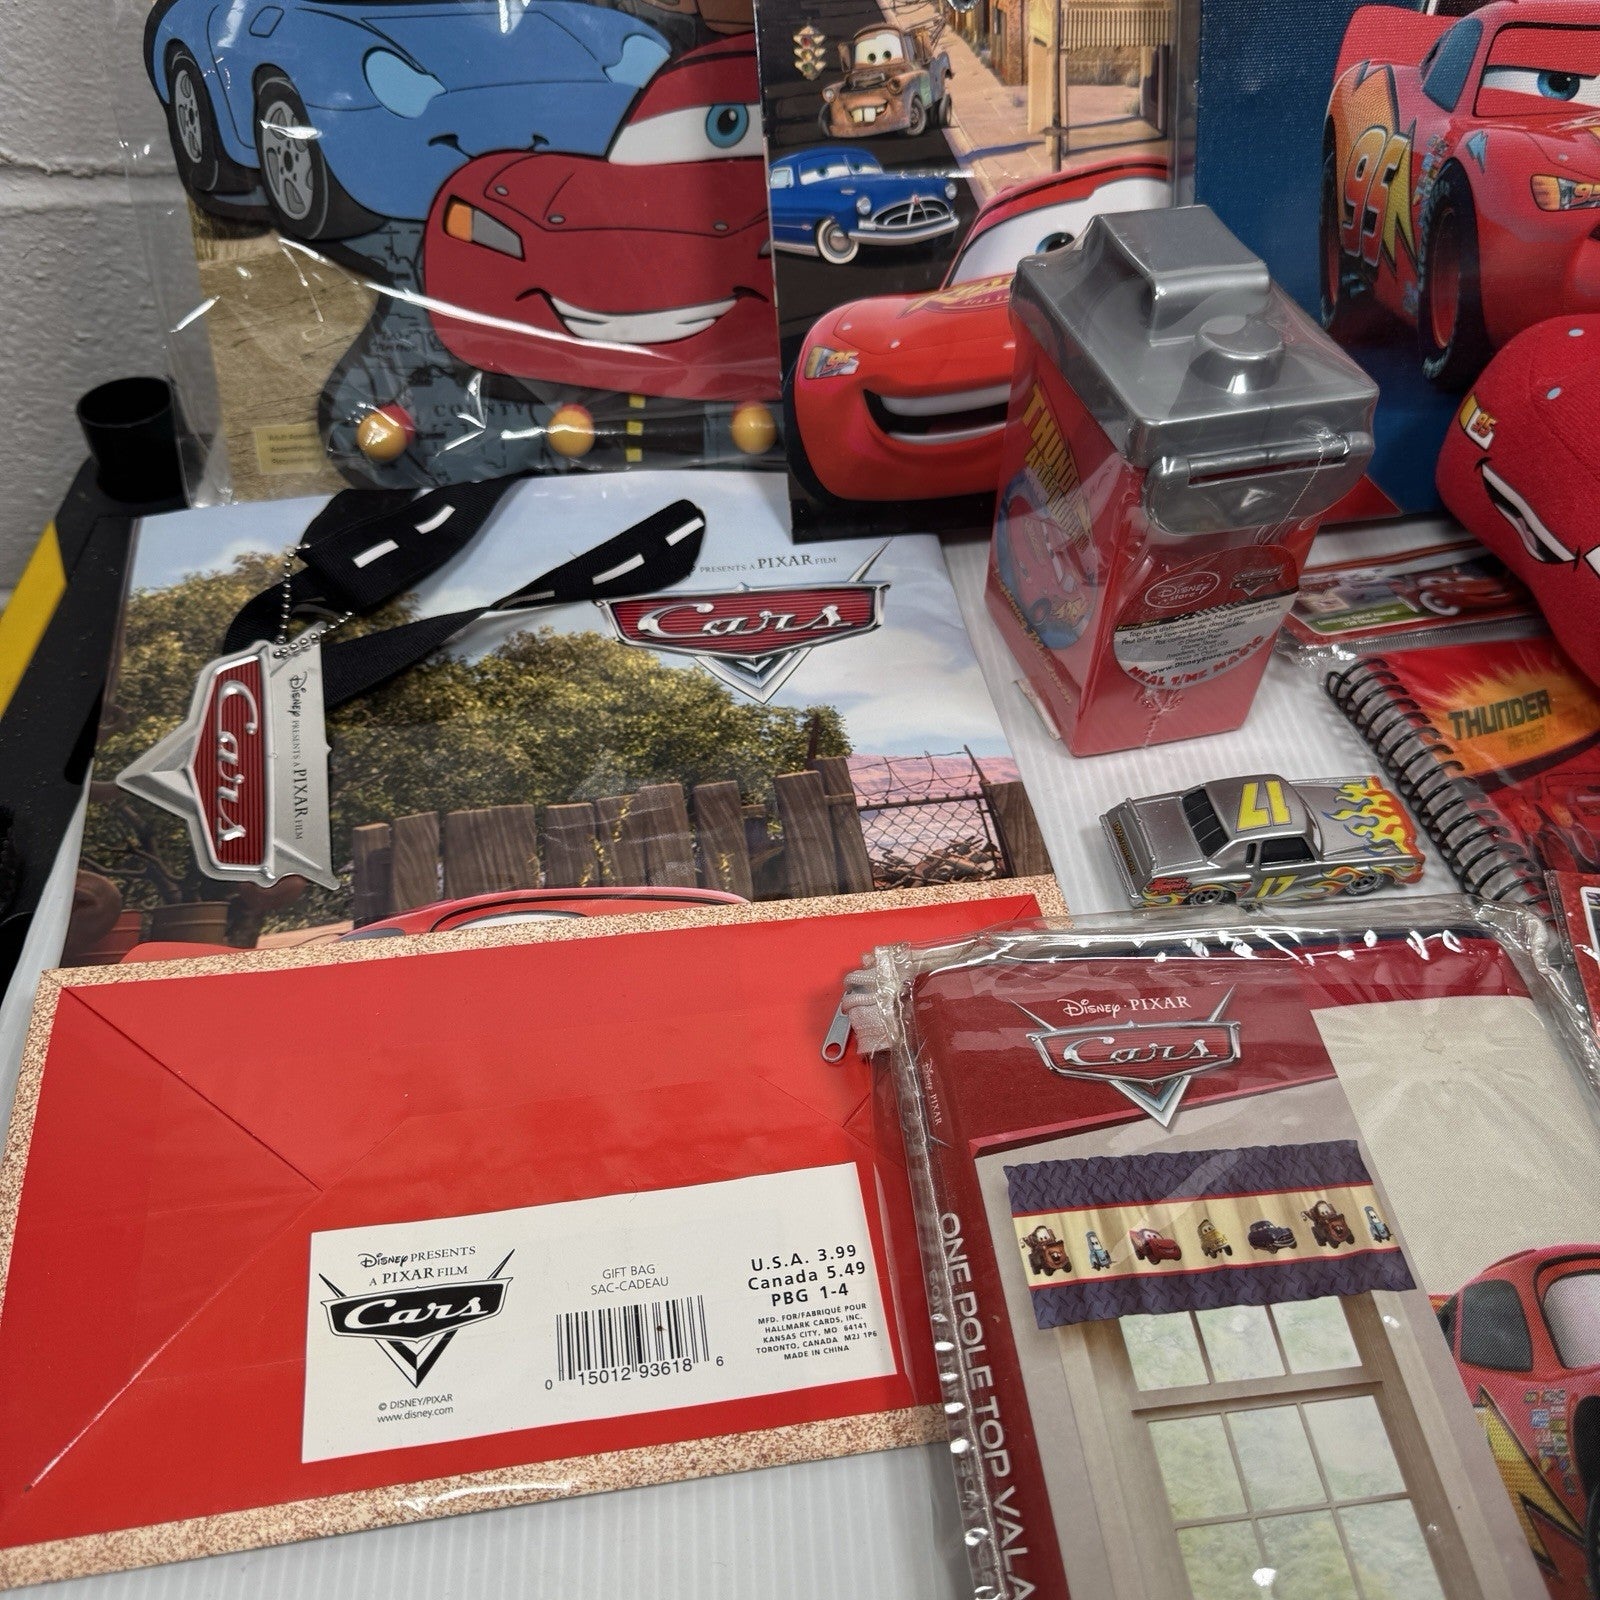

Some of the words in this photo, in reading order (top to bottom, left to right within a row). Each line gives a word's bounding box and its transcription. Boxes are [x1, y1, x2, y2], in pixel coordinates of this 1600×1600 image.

[699, 564, 746, 573] PRESENTS
[757, 554, 813, 569] PIXAR
[637, 602, 853, 638] Cars
[287, 670, 308, 717] Disney
[1448, 690, 1552, 740] THUNDER
[216, 680, 259, 850] Cars
[293, 768, 308, 817] PIXAR
[1255, 874, 1299, 898] 17
[1057, 998, 1121, 1018] Disney
[1129, 996, 1192, 1011] PIXAR
[1063, 1036, 1218, 1065] Cars
[930, 1093, 943, 1126] PIXAR
[357, 1252, 409, 1268] Disney
[410, 1246, 476, 1263] PRESENTS
[751, 1252, 809, 1272] U.S.A.
[817, 1244, 856, 1262] 3.99
[939, 1212, 972, 1286] ONE
[368, 1277, 378, 1287] A
[382, 1267, 435, 1284] PIXAR
[437, 1266, 468, 1278] FILM
[602, 1267, 626, 1279] GIFT
[631, 1264, 656, 1276] BAG
[747, 1269, 818, 1290] Canada
[826, 1261, 866, 1279] 5.49
[590, 1276, 669, 1295] SAC-CADEAU
[771, 1289, 809, 1307] PBG
[819, 1283, 849, 1299] 1-4
[344, 1296, 489, 1329] Cars
[757, 1317, 779, 1325] MFD.
[844, 1303, 867, 1312] POUR
[765, 1322, 811, 1334] HALLMARK
[813, 1316, 843, 1327] CARDS,
[846, 1313, 864, 1321] INC.
[756, 1343, 800, 1354] TORONTO,
[803, 1337, 839, 1348] CANADA
[844, 1333, 860, 1341] M2J
[863, 1330, 878, 1339] 1P6
[763, 1333, 797, 1343] KANSAS
[799, 1330, 821, 1339] CITY,
[824, 1327, 838, 1335] MO
[844, 1322, 868, 1332] 64141
[954, 1291, 994, 1391] POLE
[784, 1350, 809, 1360] MADE
[811, 1348, 821, 1356] IN
[824, 1345, 850, 1355] CHINA
[545, 1379, 553, 1390] 0
[578, 1367, 631, 1386] 15012
[639, 1358, 693, 1378] 93618
[716, 1356, 724, 1367] 6
[390, 1394, 453, 1410] DISNEY/PIXAR
[377, 1406, 454, 1423] www.disney.com
[975, 1395, 1011, 1479] TOP
